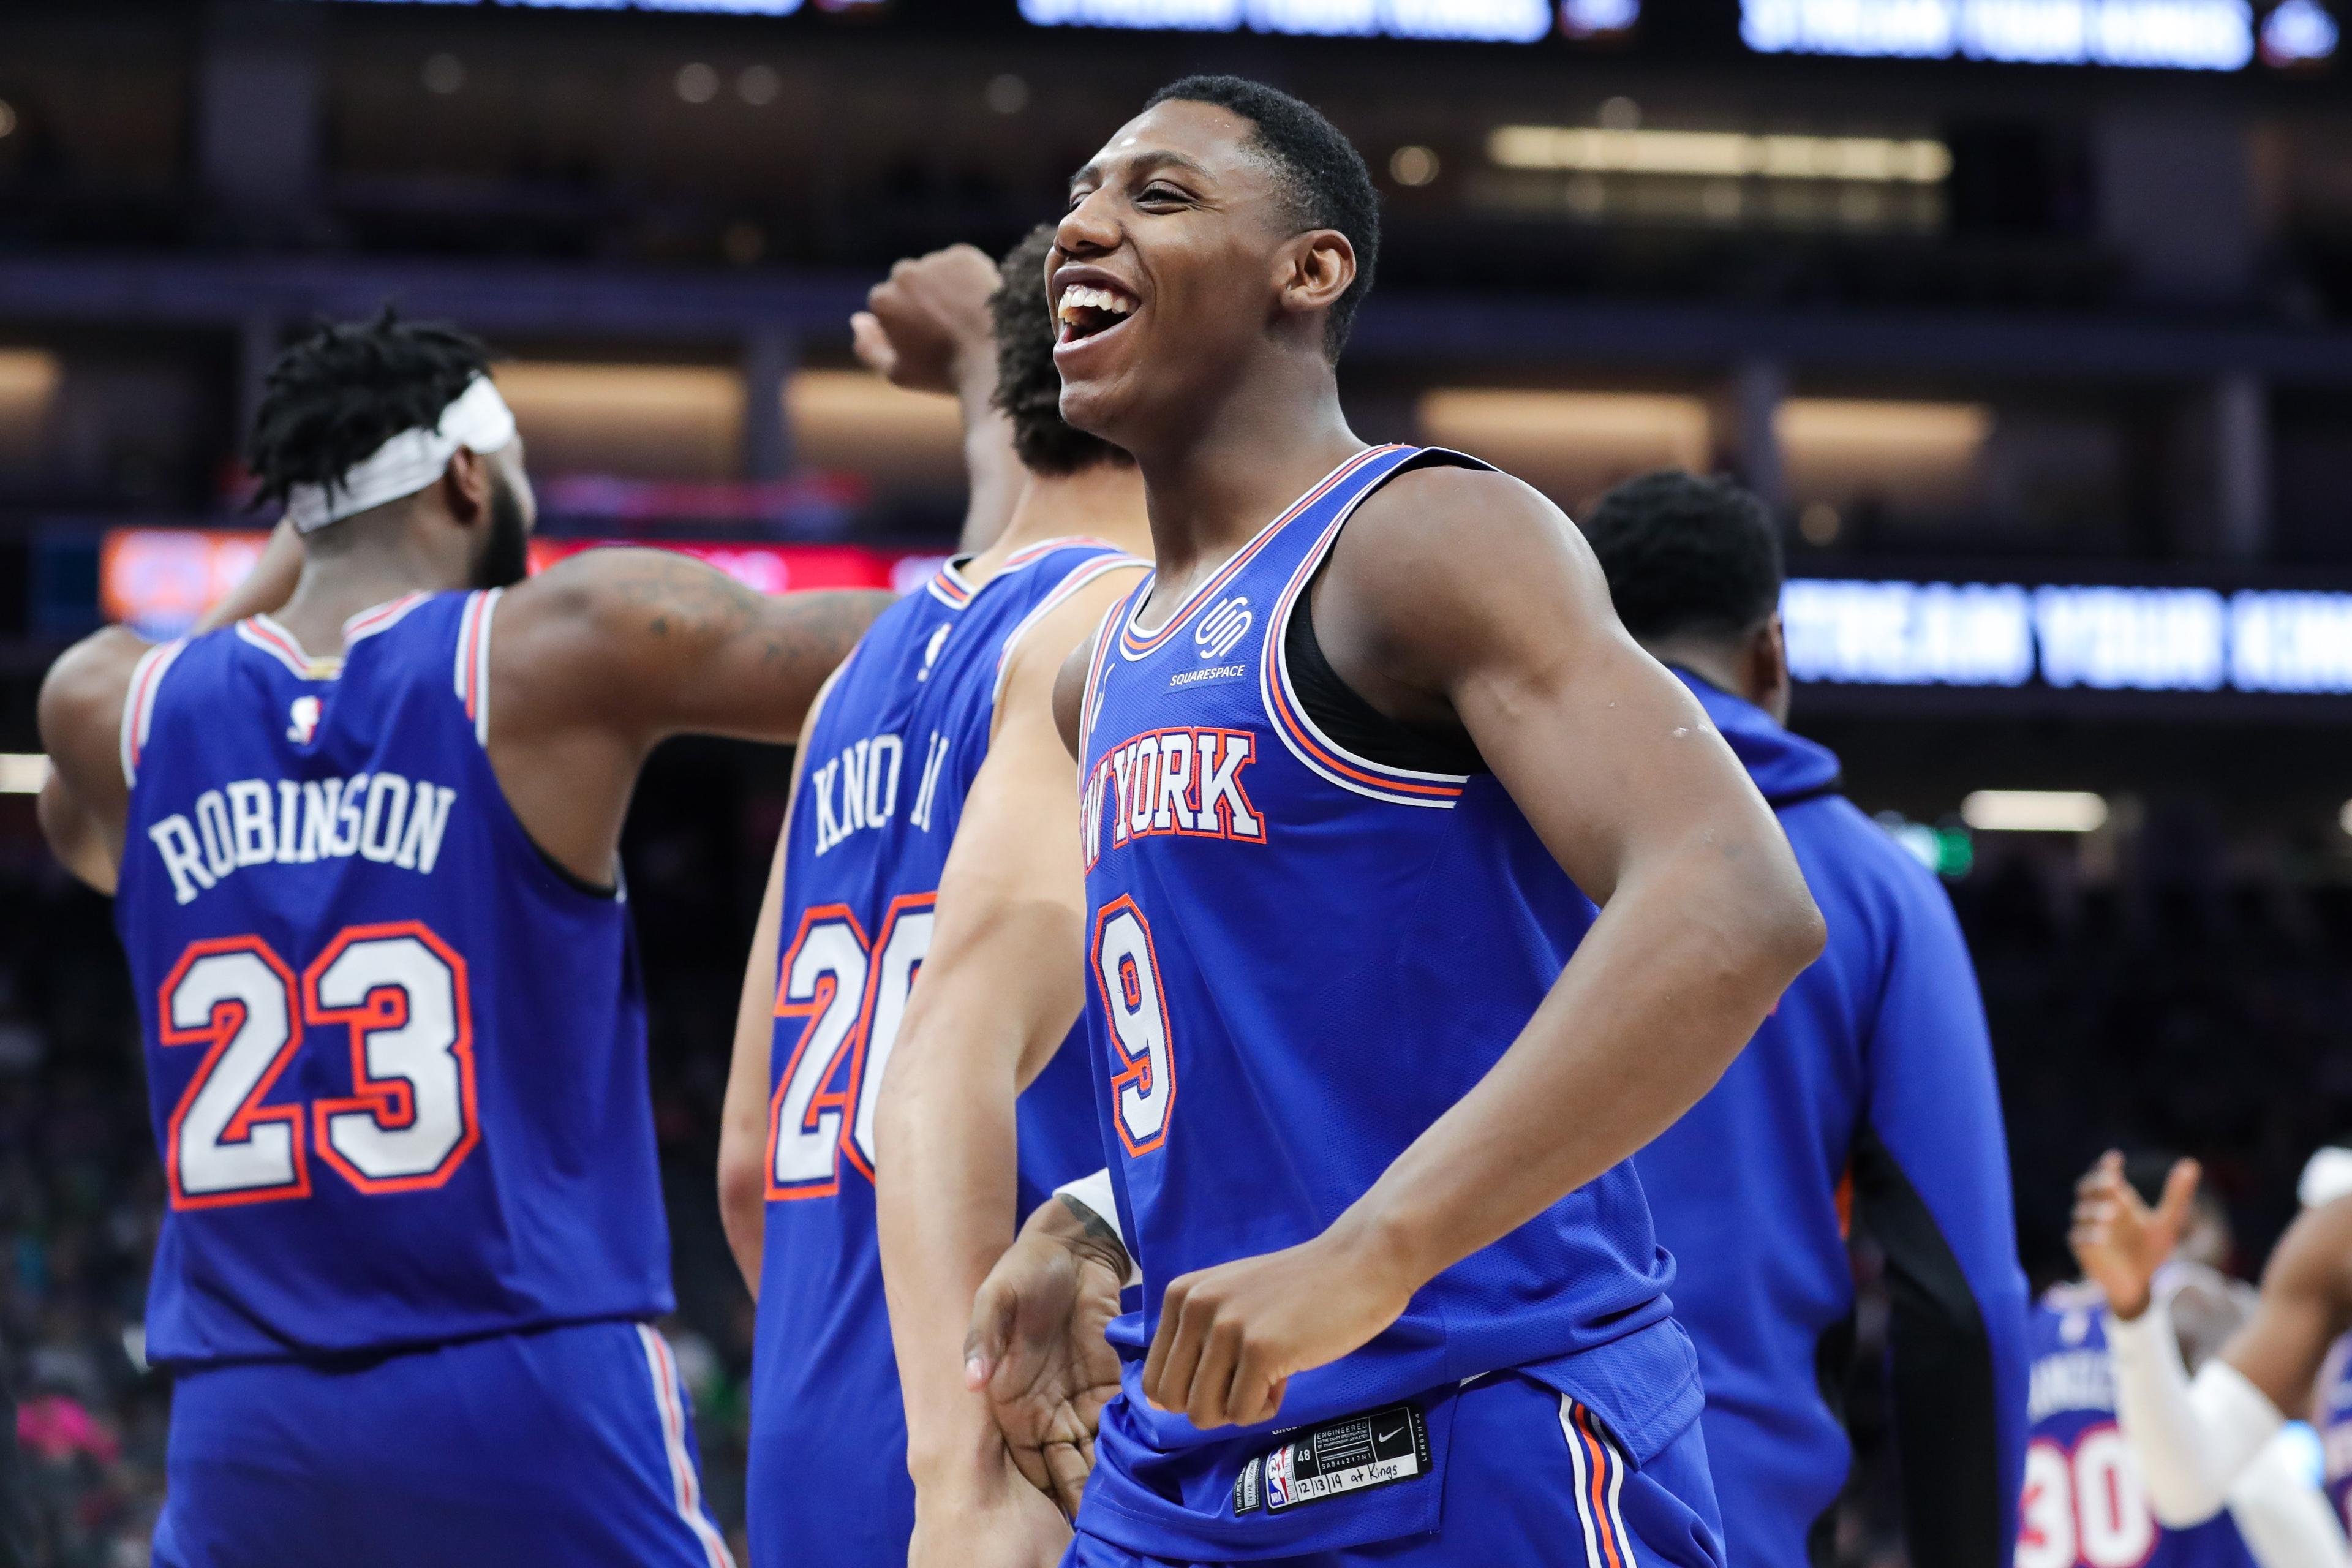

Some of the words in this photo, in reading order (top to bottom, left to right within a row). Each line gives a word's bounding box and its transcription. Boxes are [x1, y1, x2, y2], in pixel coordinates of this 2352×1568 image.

[1170, 665, 1245, 686] SQUARESPACE
[148, 772, 457, 905] ROBINSON
[812, 733, 903, 858] KNO
[1110, 726, 1267, 850] YORK
[158, 919, 480, 1211] 23
[1091, 894, 1177, 1158] 9
[1297, 1449, 1310, 1462] 48
[1317, 1422, 1367, 1439] ENGINEERED
[1351, 1469, 1363, 1482] at
[1366, 1462, 1398, 1480] Kings
[1270, 1491, 1283, 1504] NBA
[2013, 1419, 2162, 1568] 30
